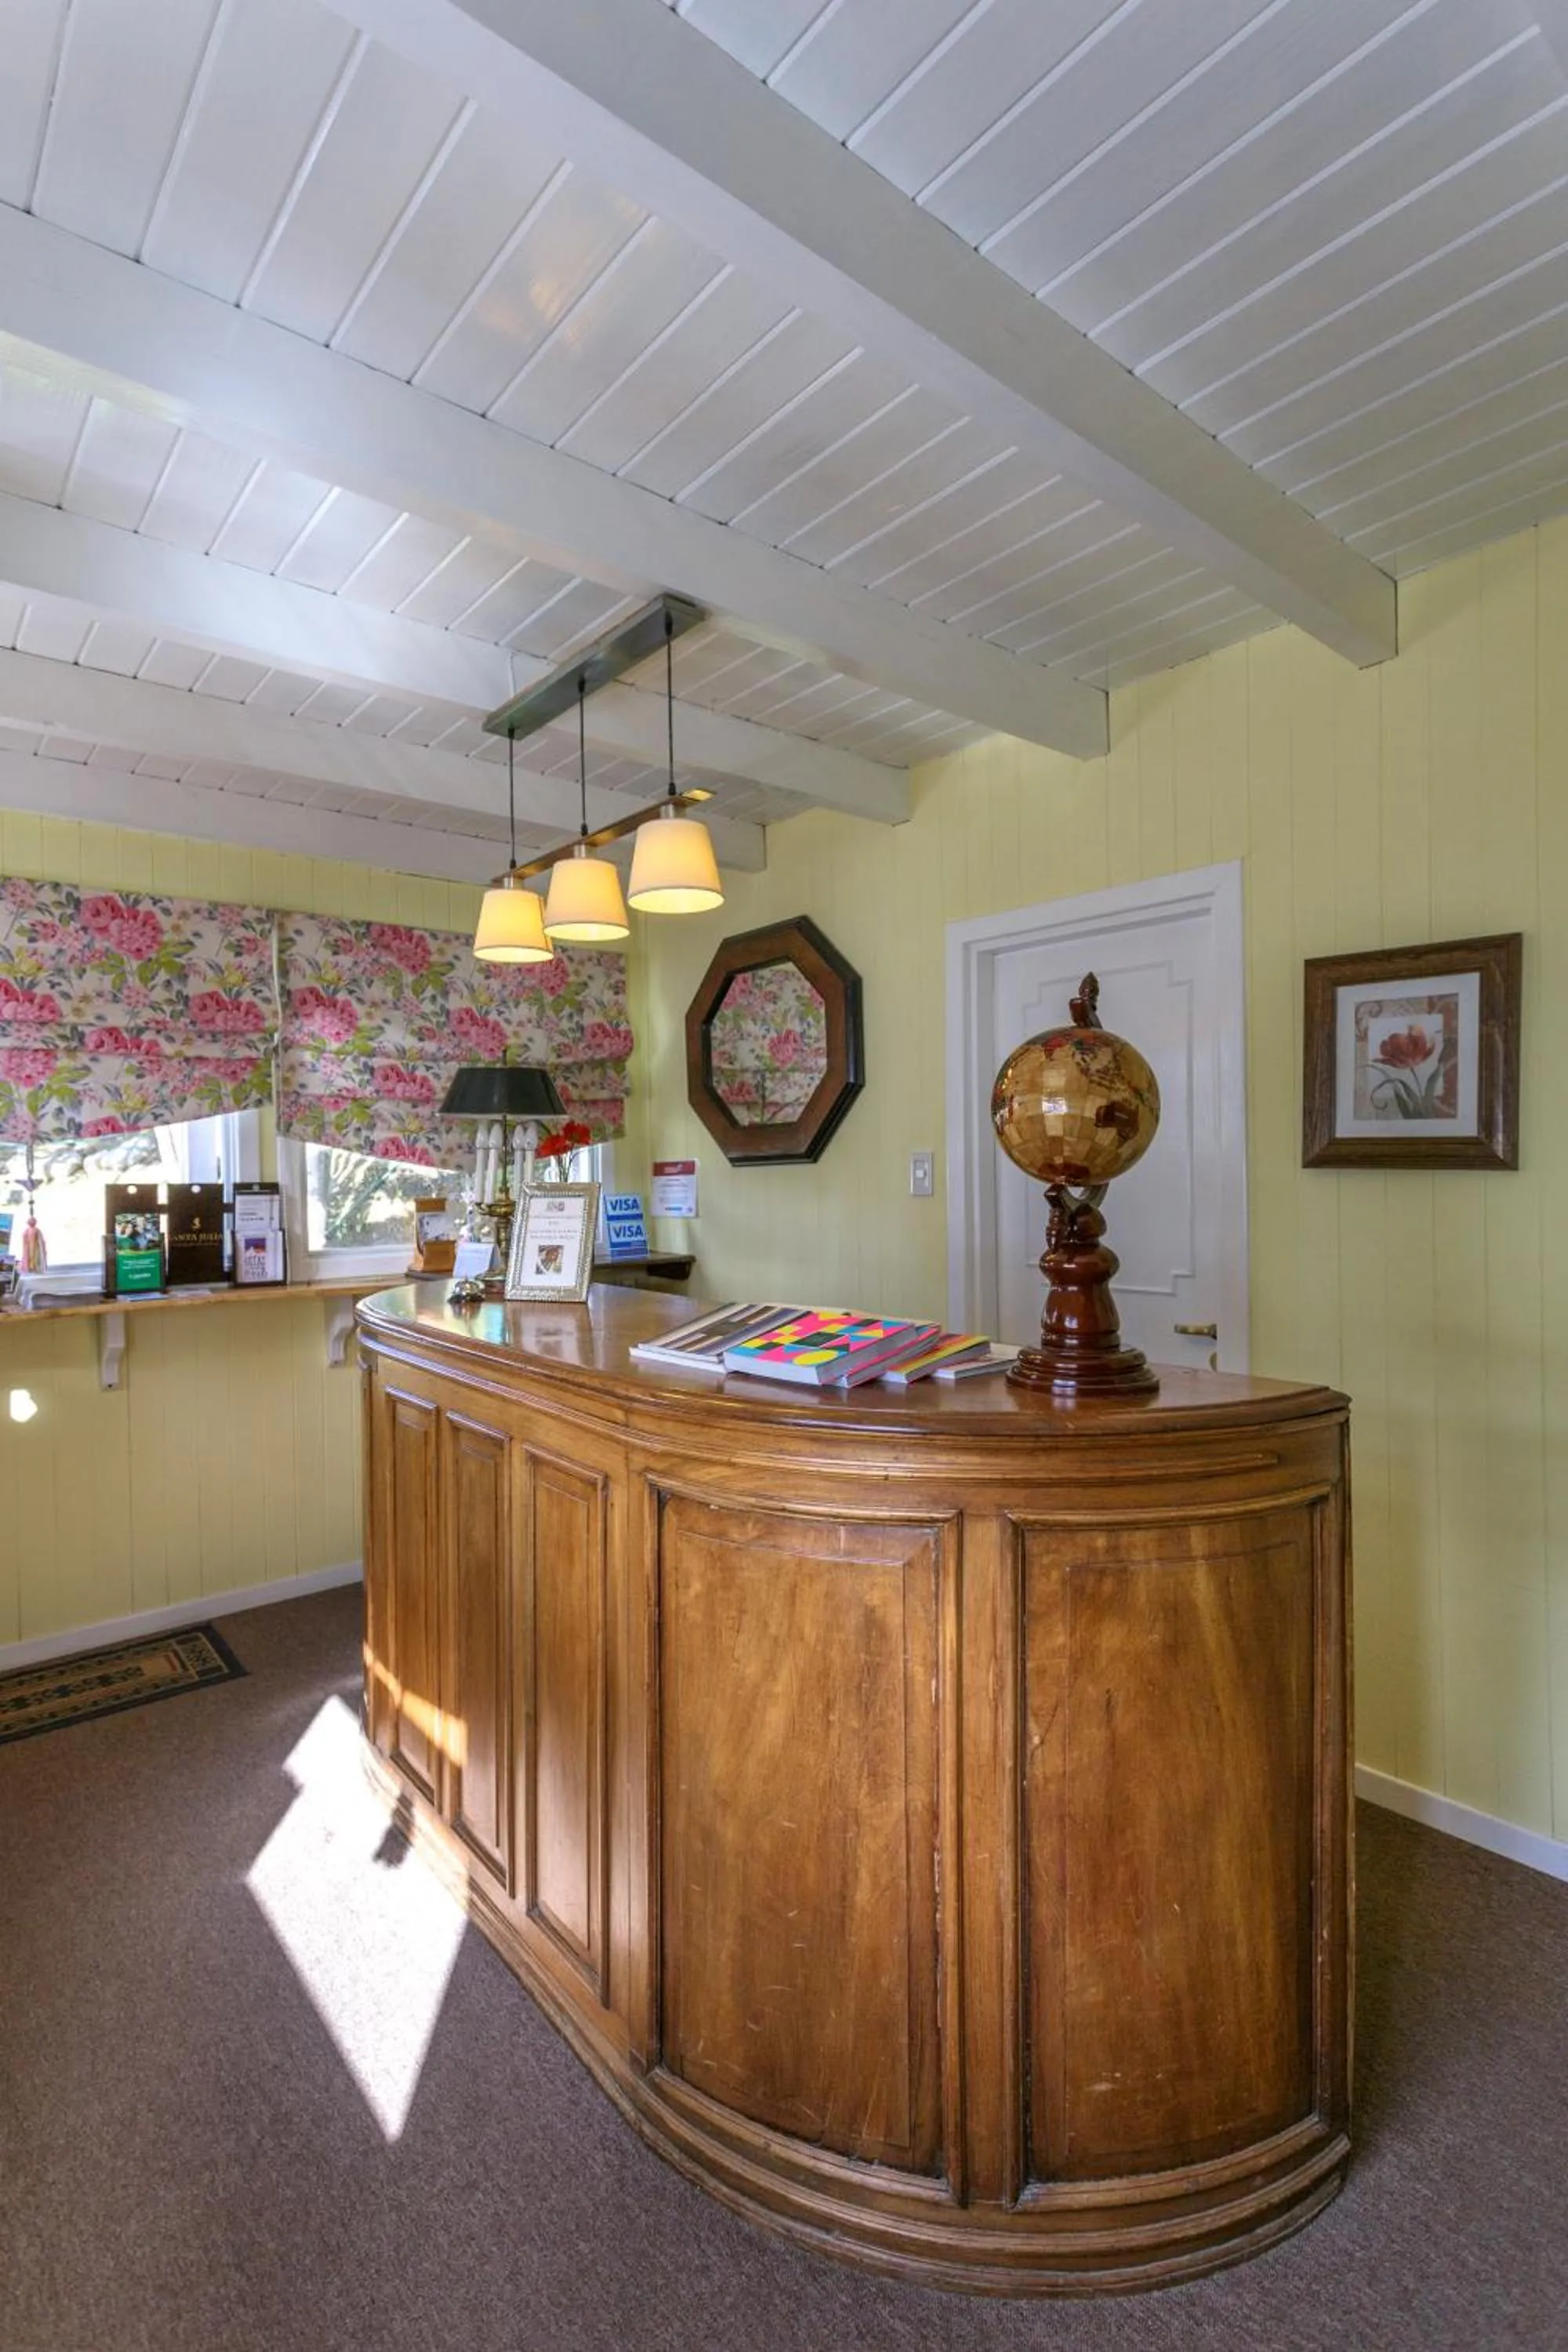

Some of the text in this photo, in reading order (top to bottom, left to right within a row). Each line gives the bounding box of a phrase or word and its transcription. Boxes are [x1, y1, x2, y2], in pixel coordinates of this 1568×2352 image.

[610, 1198, 640, 1211] VISA
[169, 1232, 198, 1241] ANTA
[613, 1225, 644, 1238] VISA
